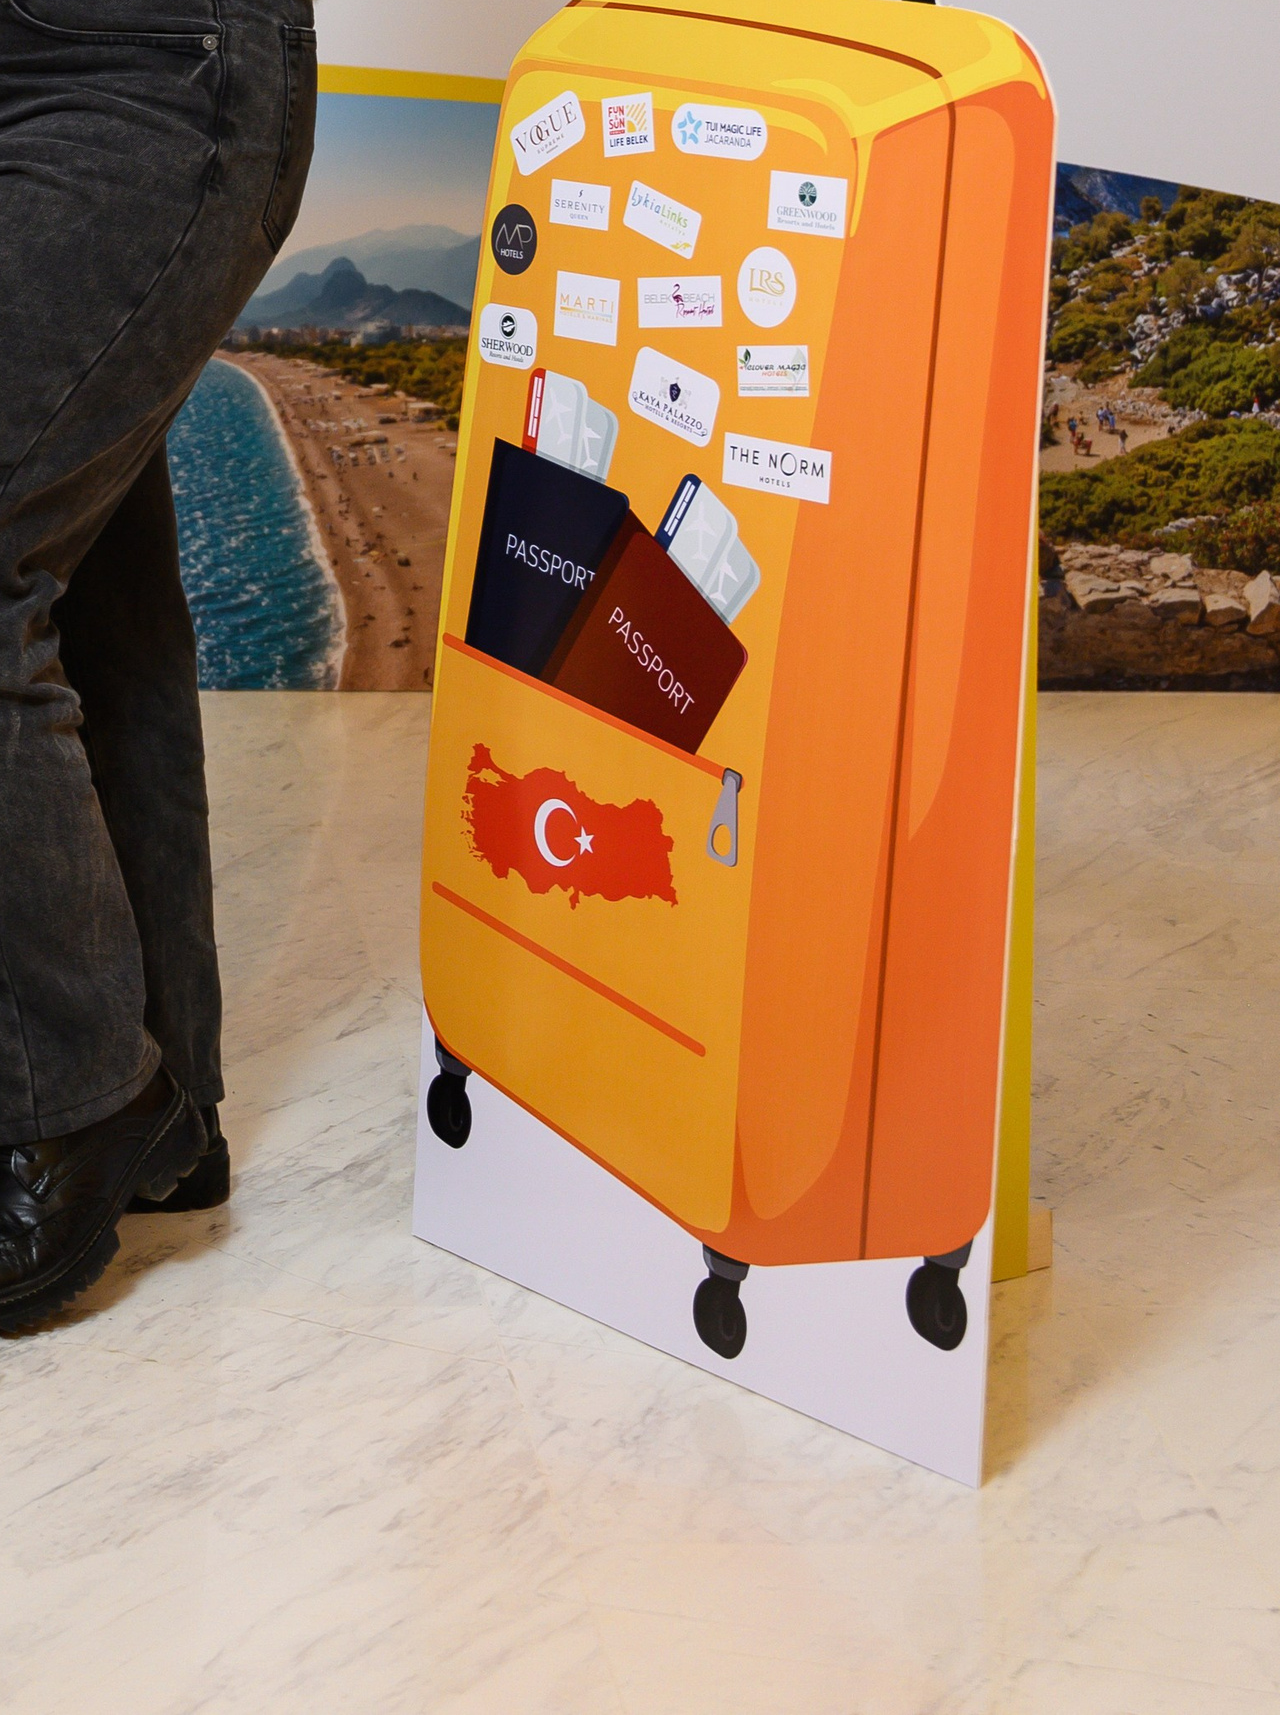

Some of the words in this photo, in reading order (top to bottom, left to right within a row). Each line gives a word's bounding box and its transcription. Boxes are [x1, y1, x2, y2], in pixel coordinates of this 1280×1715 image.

[515, 101, 578, 154] VOGUE
[705, 121, 718, 132] TUI
[719, 123, 744, 135] MAGIC
[745, 127, 762, 137] LIFE
[609, 137, 624, 148] LIFE
[626, 135, 649, 146] BELEK
[704, 134, 752, 148] JACARANDA
[554, 198, 605, 214] SERENITY
[776, 205, 837, 223] GREENWOOD
[495, 222, 533, 253] MP
[500, 248, 524, 260] HOTELS
[749, 267, 785, 297] LRS
[560, 293, 614, 314] MARTI
[683, 292, 715, 303] BEACH
[481, 337, 534, 357] SHERWOOD
[638, 390, 661, 410] KAYA
[663, 403, 703, 430] PALAZZO
[730, 445, 760, 466] THE
[768, 452, 825, 478] NORM
[759, 476, 791, 488] HOTELS
[607, 606, 696, 715] PASSPORT
